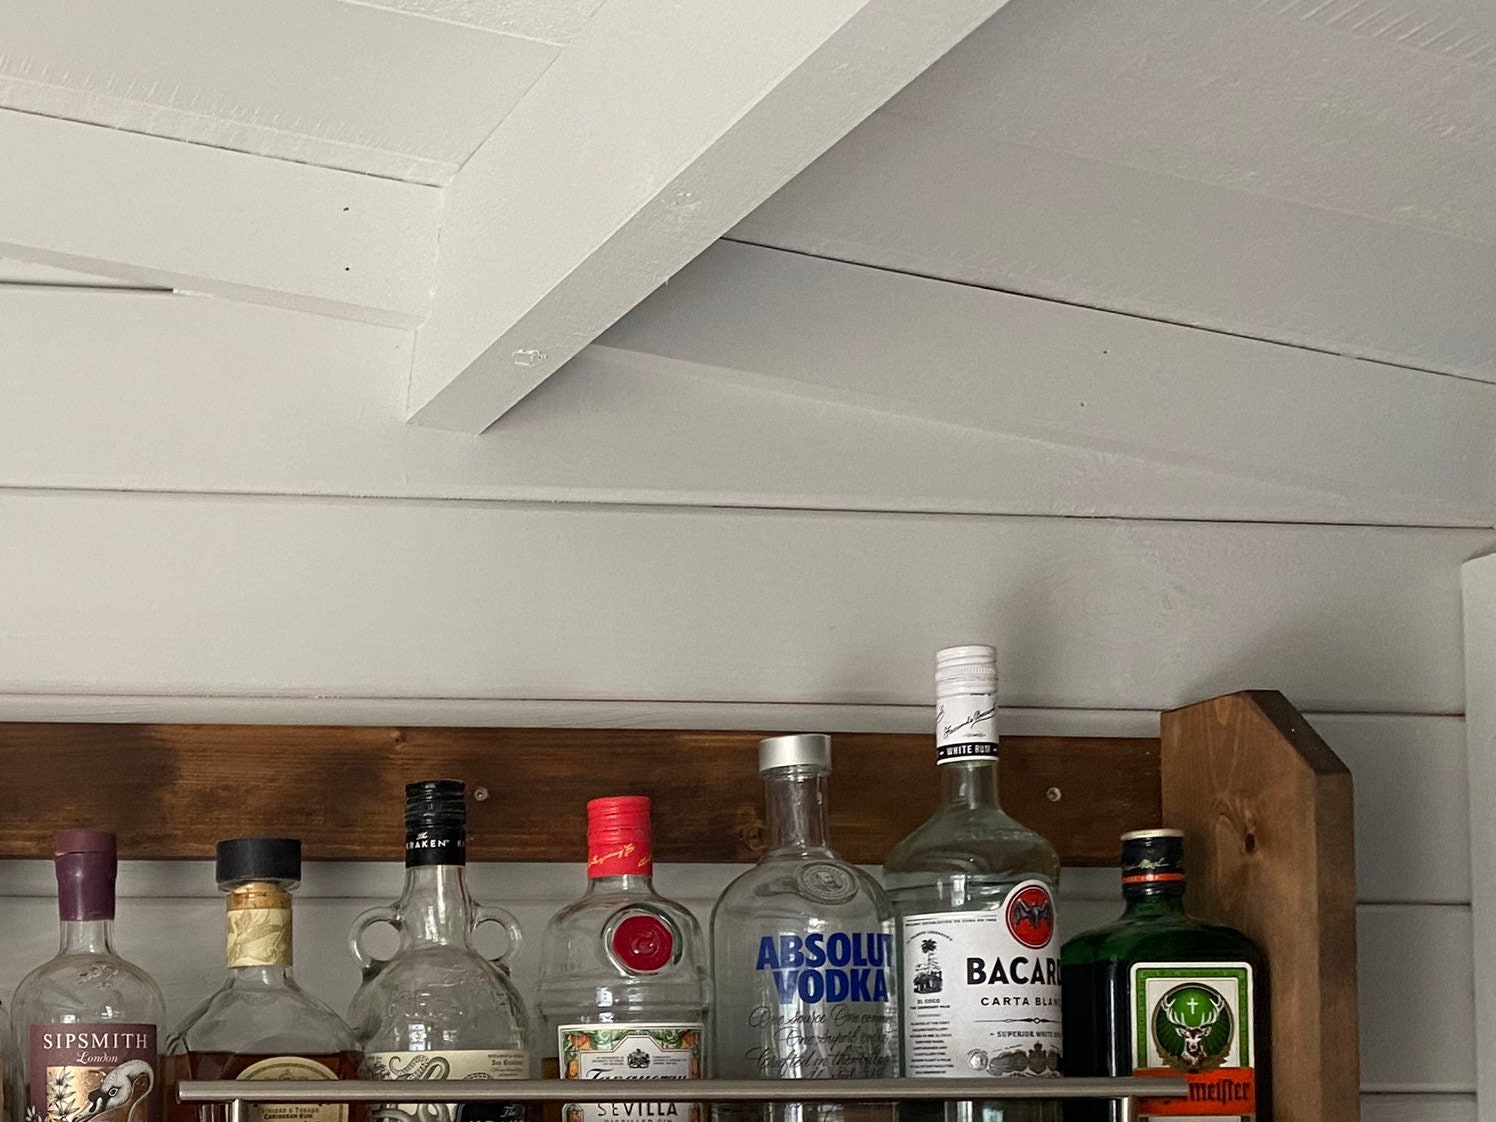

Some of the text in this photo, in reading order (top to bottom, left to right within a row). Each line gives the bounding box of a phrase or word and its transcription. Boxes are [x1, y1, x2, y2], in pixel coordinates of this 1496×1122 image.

[946, 744, 991, 756] WHITE RUM
[756, 932, 893, 970] ABSOLUT
[967, 956, 1062, 986] BACAR
[772, 968, 888, 1004] VODKA
[980, 996, 1061, 1006] CARTA BLAN
[43, 1032, 147, 1050] SIPSMITH
[76, 1051, 118, 1064] London
[598, 1102, 678, 1116] SEVILLA
